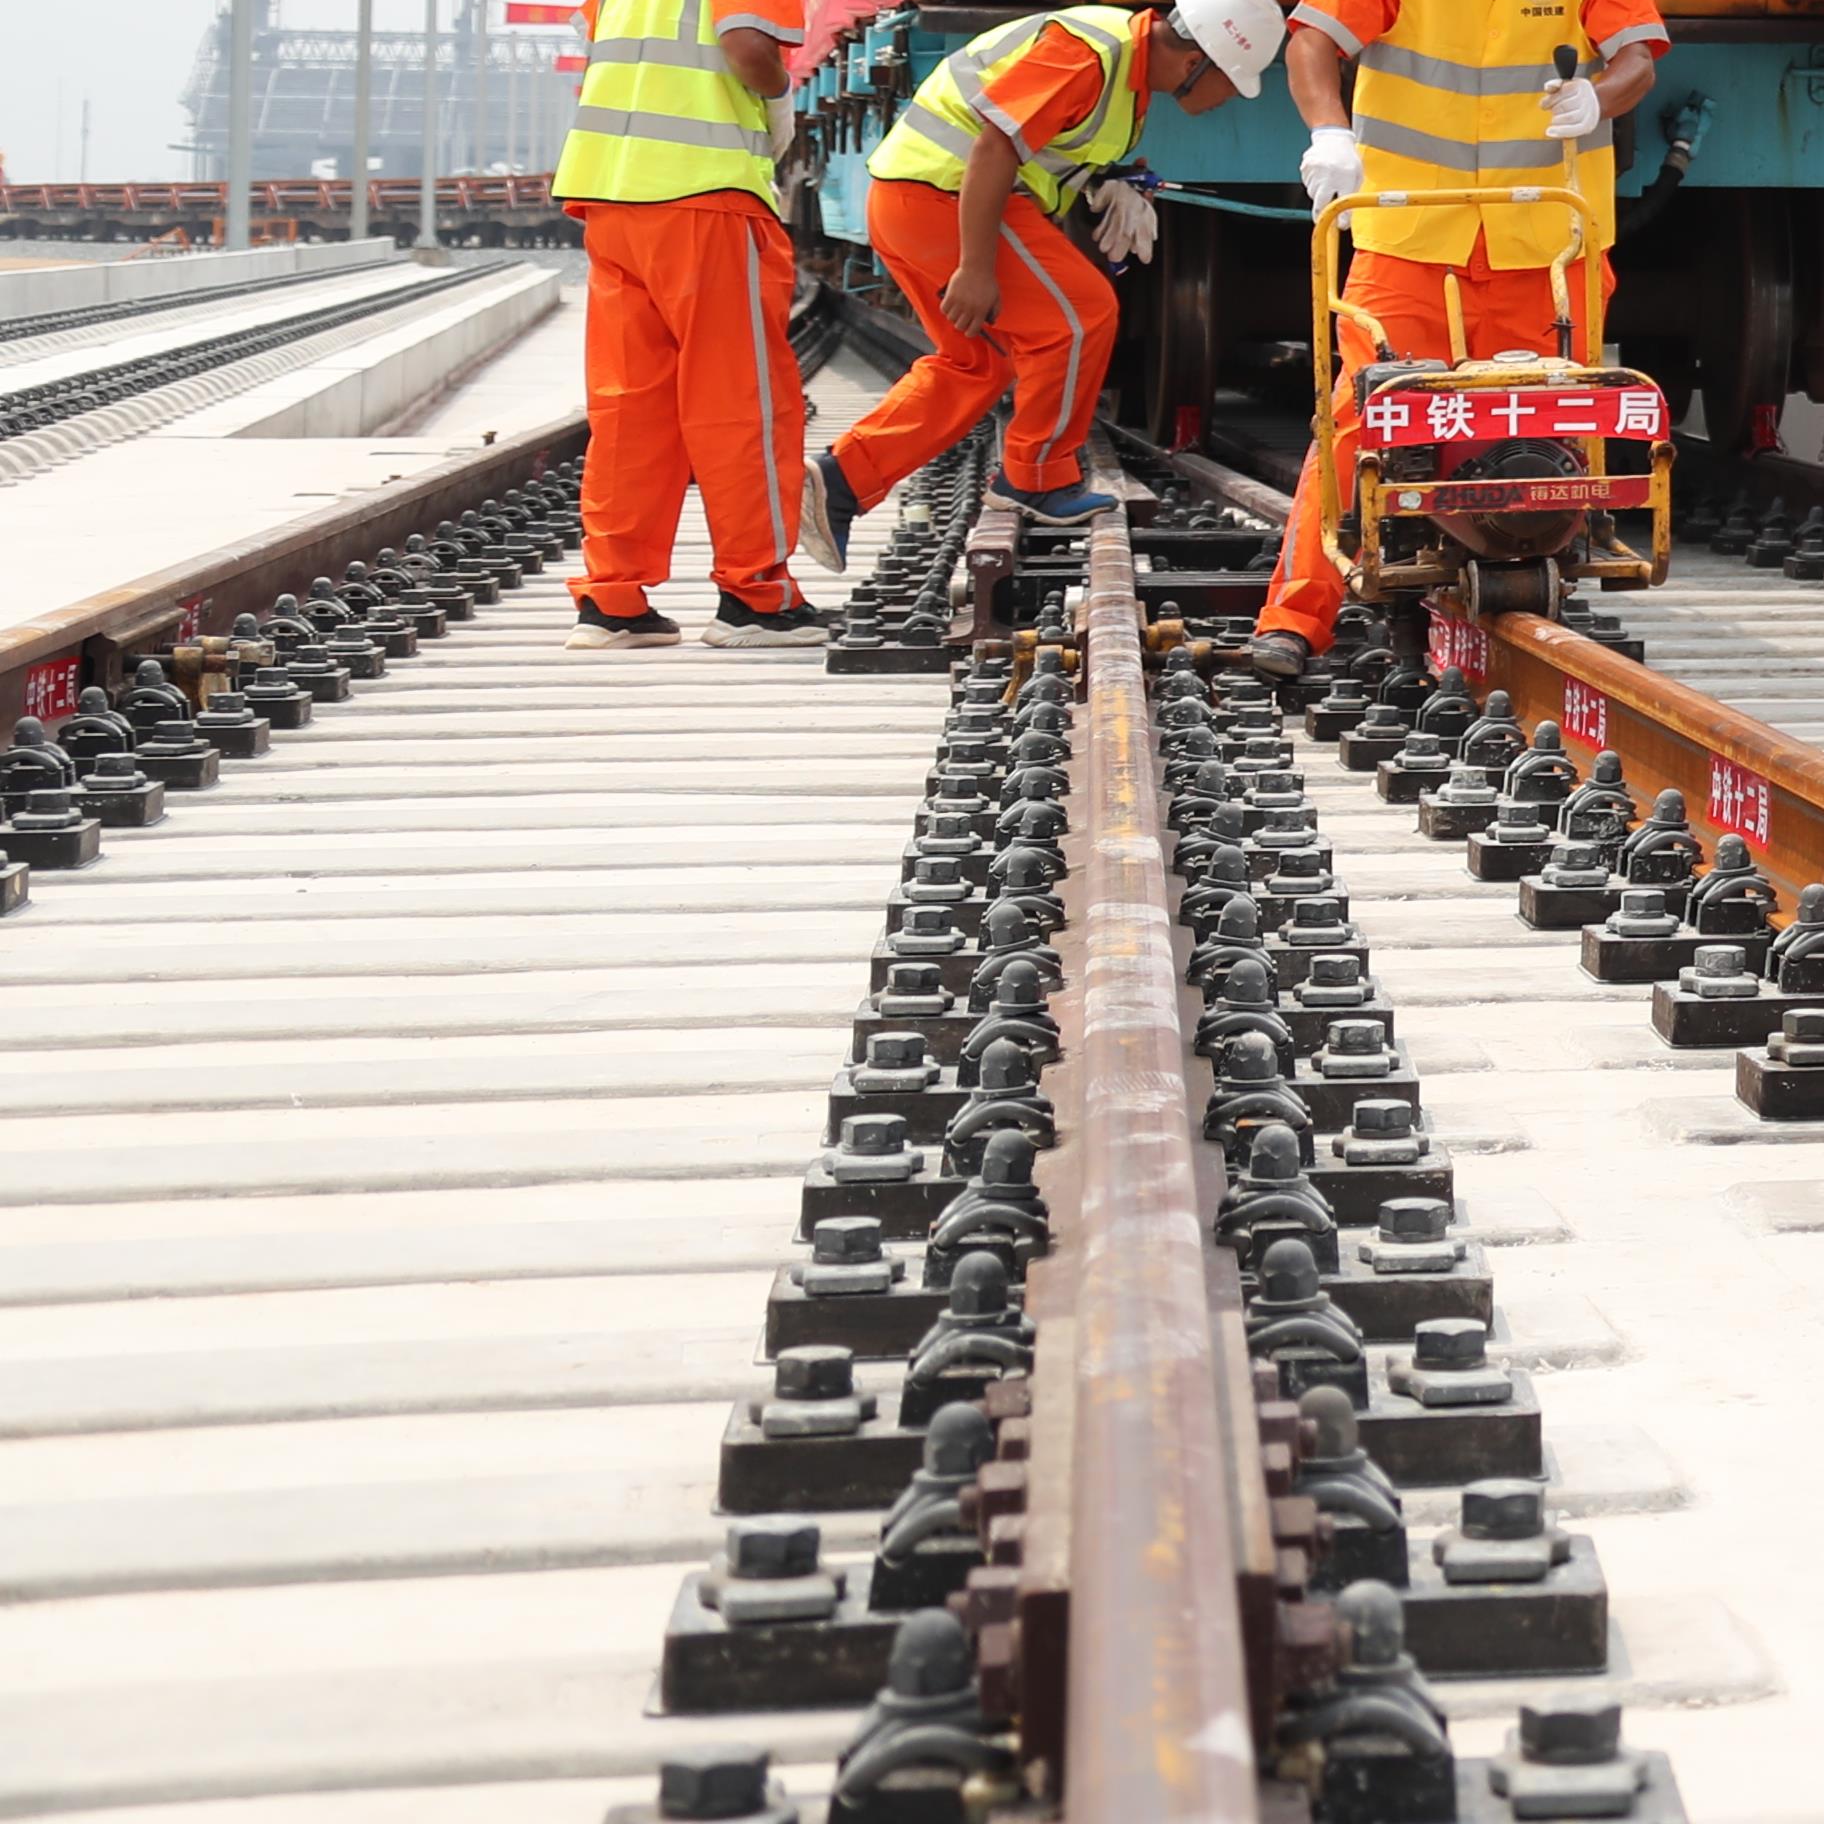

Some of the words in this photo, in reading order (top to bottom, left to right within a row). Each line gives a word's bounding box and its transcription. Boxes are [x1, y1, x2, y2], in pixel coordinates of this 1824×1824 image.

[1520, 5, 1565, 17] 中国铁建
[1366, 391, 1662, 442] 中铁十二局
[26, 664, 78, 718] 中铁十二局
[1564, 679, 1607, 748] 中铁十二局
[1710, 759, 1770, 847] 中铁十二局
